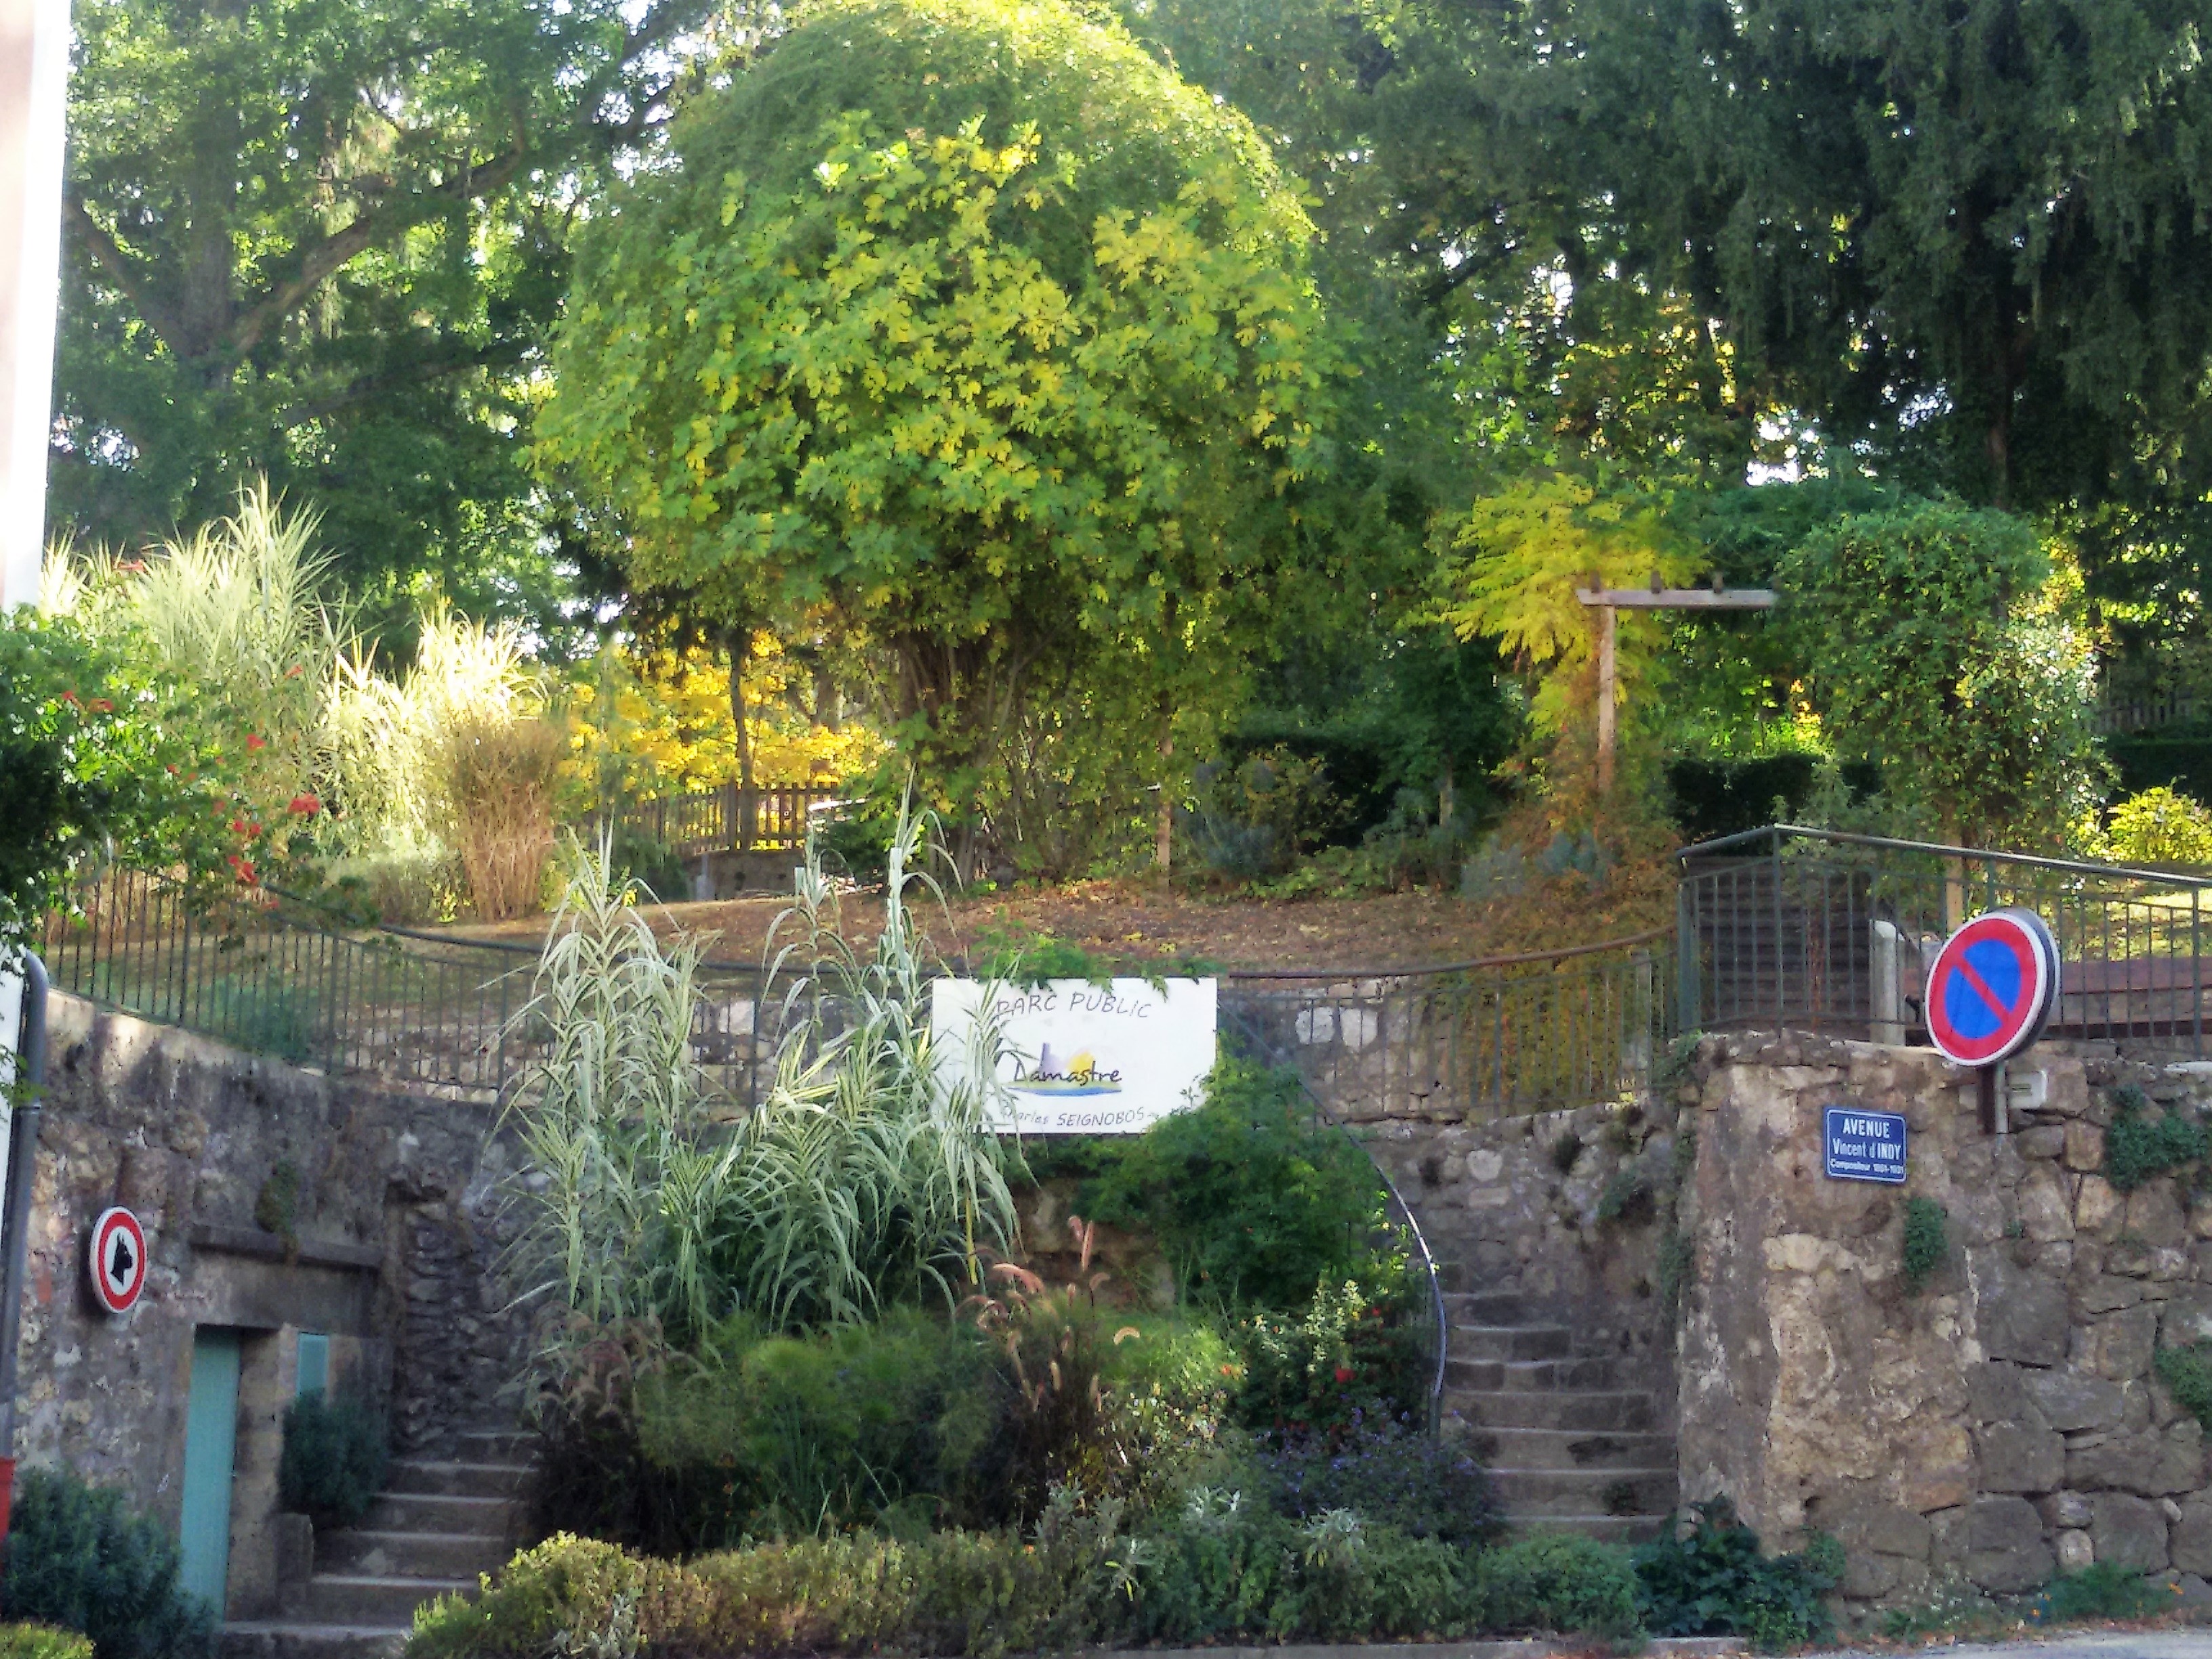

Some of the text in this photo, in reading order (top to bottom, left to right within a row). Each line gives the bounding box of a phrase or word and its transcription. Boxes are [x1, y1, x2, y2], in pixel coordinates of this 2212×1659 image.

[997, 991, 1151, 1019] PARC PUBLIC
[1057, 1106, 1145, 1126] SEIGNOBOS
[1842, 1118, 1891, 1139] AVENUE
[1832, 1138, 1867, 1158] Vincent
